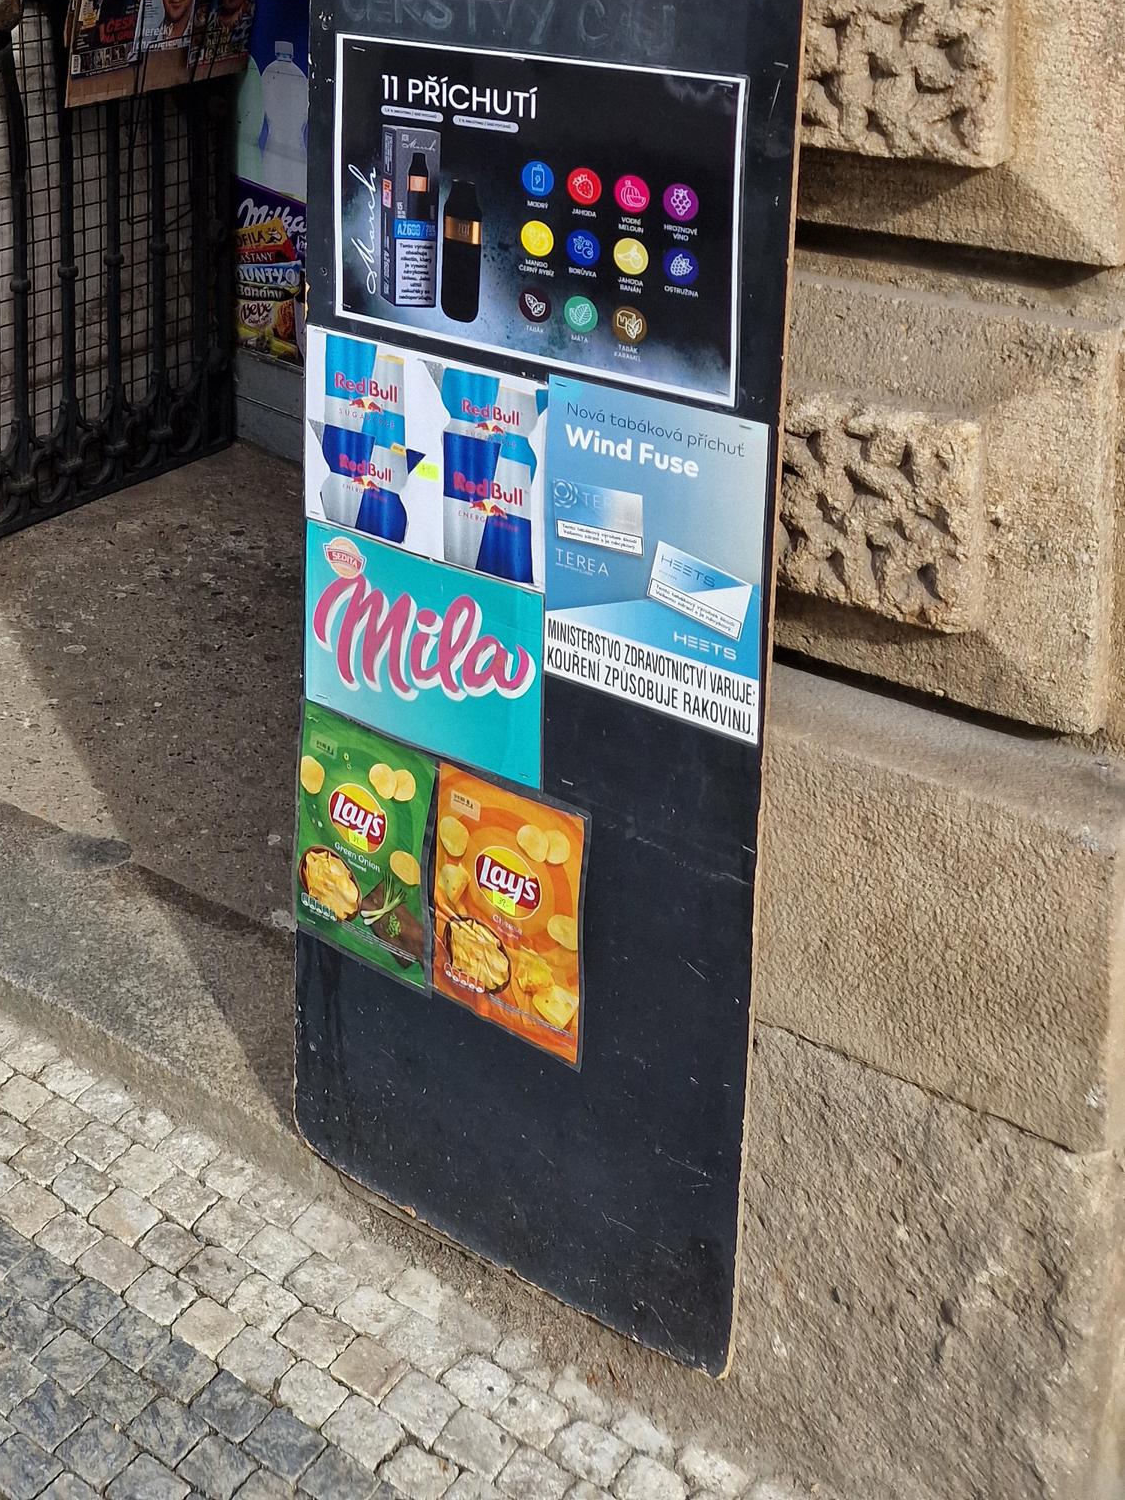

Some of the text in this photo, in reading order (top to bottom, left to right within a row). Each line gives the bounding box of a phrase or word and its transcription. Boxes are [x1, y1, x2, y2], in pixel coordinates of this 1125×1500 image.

[382, 74, 397, 100] 11
[408, 75, 538, 119] PŘÍCHUTÍ
[527, 200, 548, 209] MODRÝ
[572, 208, 596, 218] JAHODA
[618, 223, 644, 234] MELOUN
[621, 216, 642, 225] VODNÍ
[672, 232, 689, 242] VÍNO
[525, 258, 548, 268] MANGO
[568, 267, 597, 278] BORŮVKA
[617, 277, 644, 287] JAHODA
[619, 284, 642, 294] BANÁN
[664, 285, 699, 298] OSTRUŽINA
[334, 372, 398, 403] Red Bull
[461, 399, 520, 426] Red Bull
[566, 400, 745, 460] Nová tabáková příchuť
[565, 423, 700, 479] Wind Fuse
[338, 453, 392, 483] Red Bull
[452, 471, 523, 507] Red Bull
[332, 551, 358, 567] SEDITA
[555, 548, 610, 577] TEREA
[661, 554, 716, 588] HEETS
[313, 574, 536, 702] Mila
[673, 631, 737, 661] HEETS
[547, 617, 756, 707] MINISTERSTVO ZDRAVOTNICTVÍ VARUJE:
[547, 645, 755, 737] KOUŘENÍ ZPŮSOBUJE RAKOVINU.
[332, 793, 384, 838] Lay's
[334, 841, 381, 873] Green Onion
[479, 855, 538, 905] Lay's
